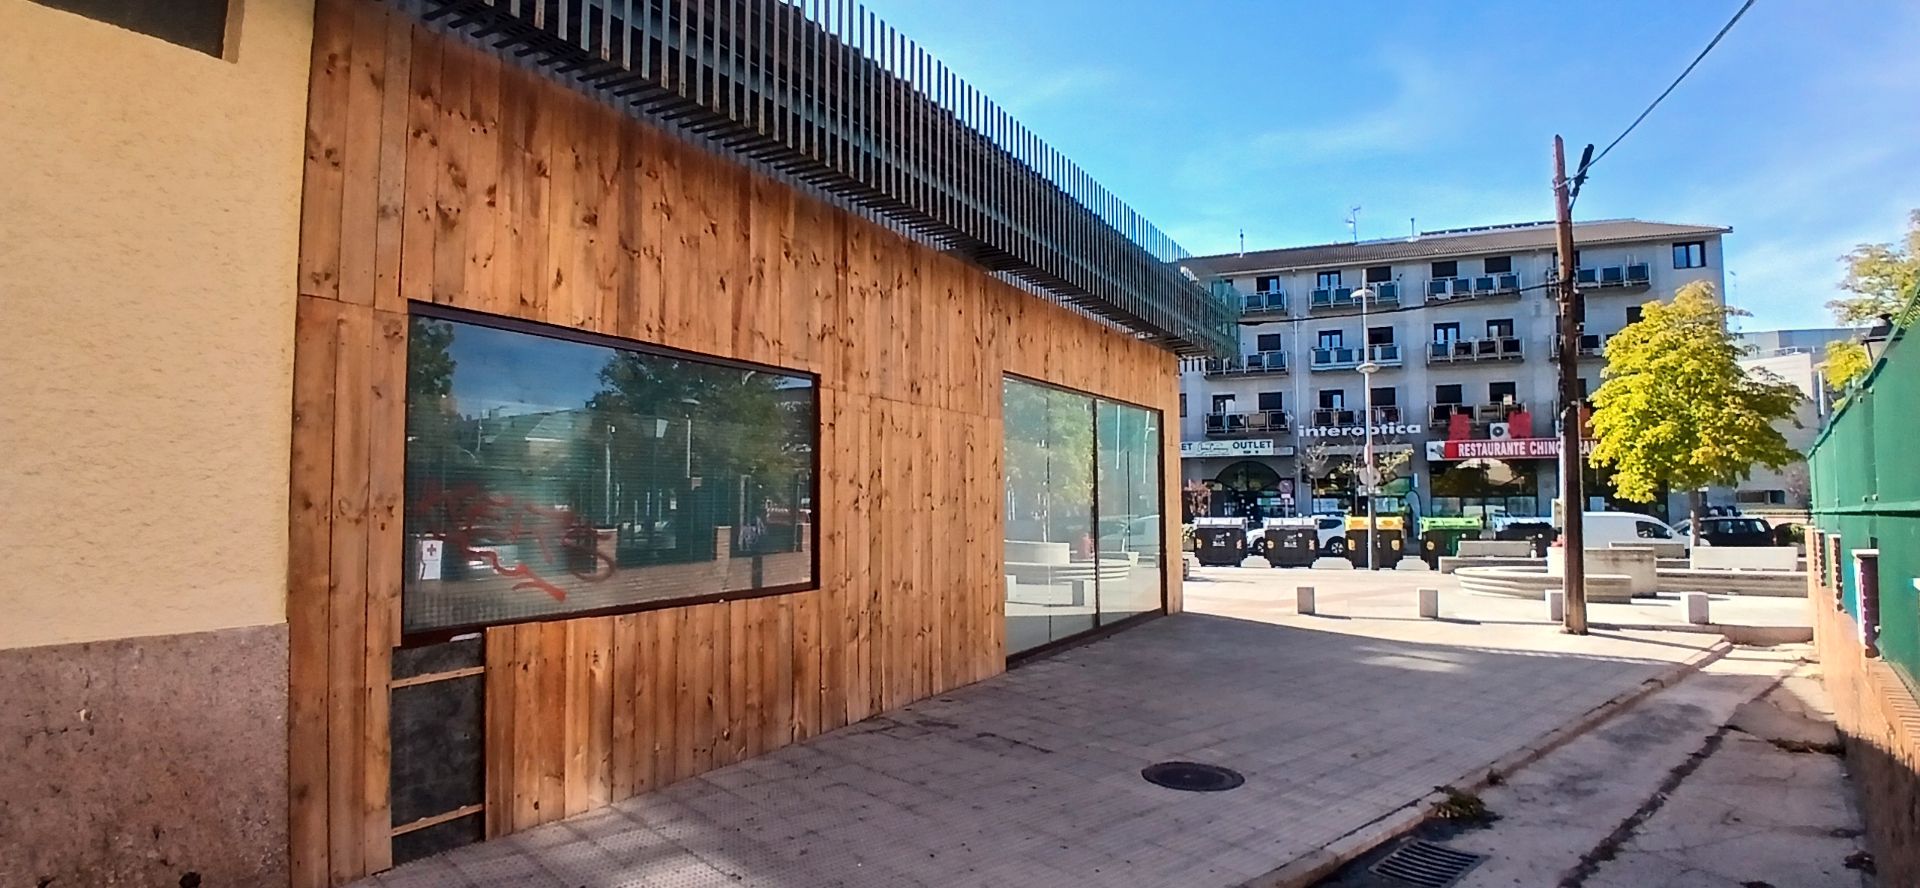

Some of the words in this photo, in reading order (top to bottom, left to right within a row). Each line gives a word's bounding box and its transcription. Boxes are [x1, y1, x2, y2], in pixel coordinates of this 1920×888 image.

[1297, 421, 1421, 437] interoptica
[1232, 440, 1272, 449] OUTLET
[1458, 441, 1526, 457] RESTAURANTE
